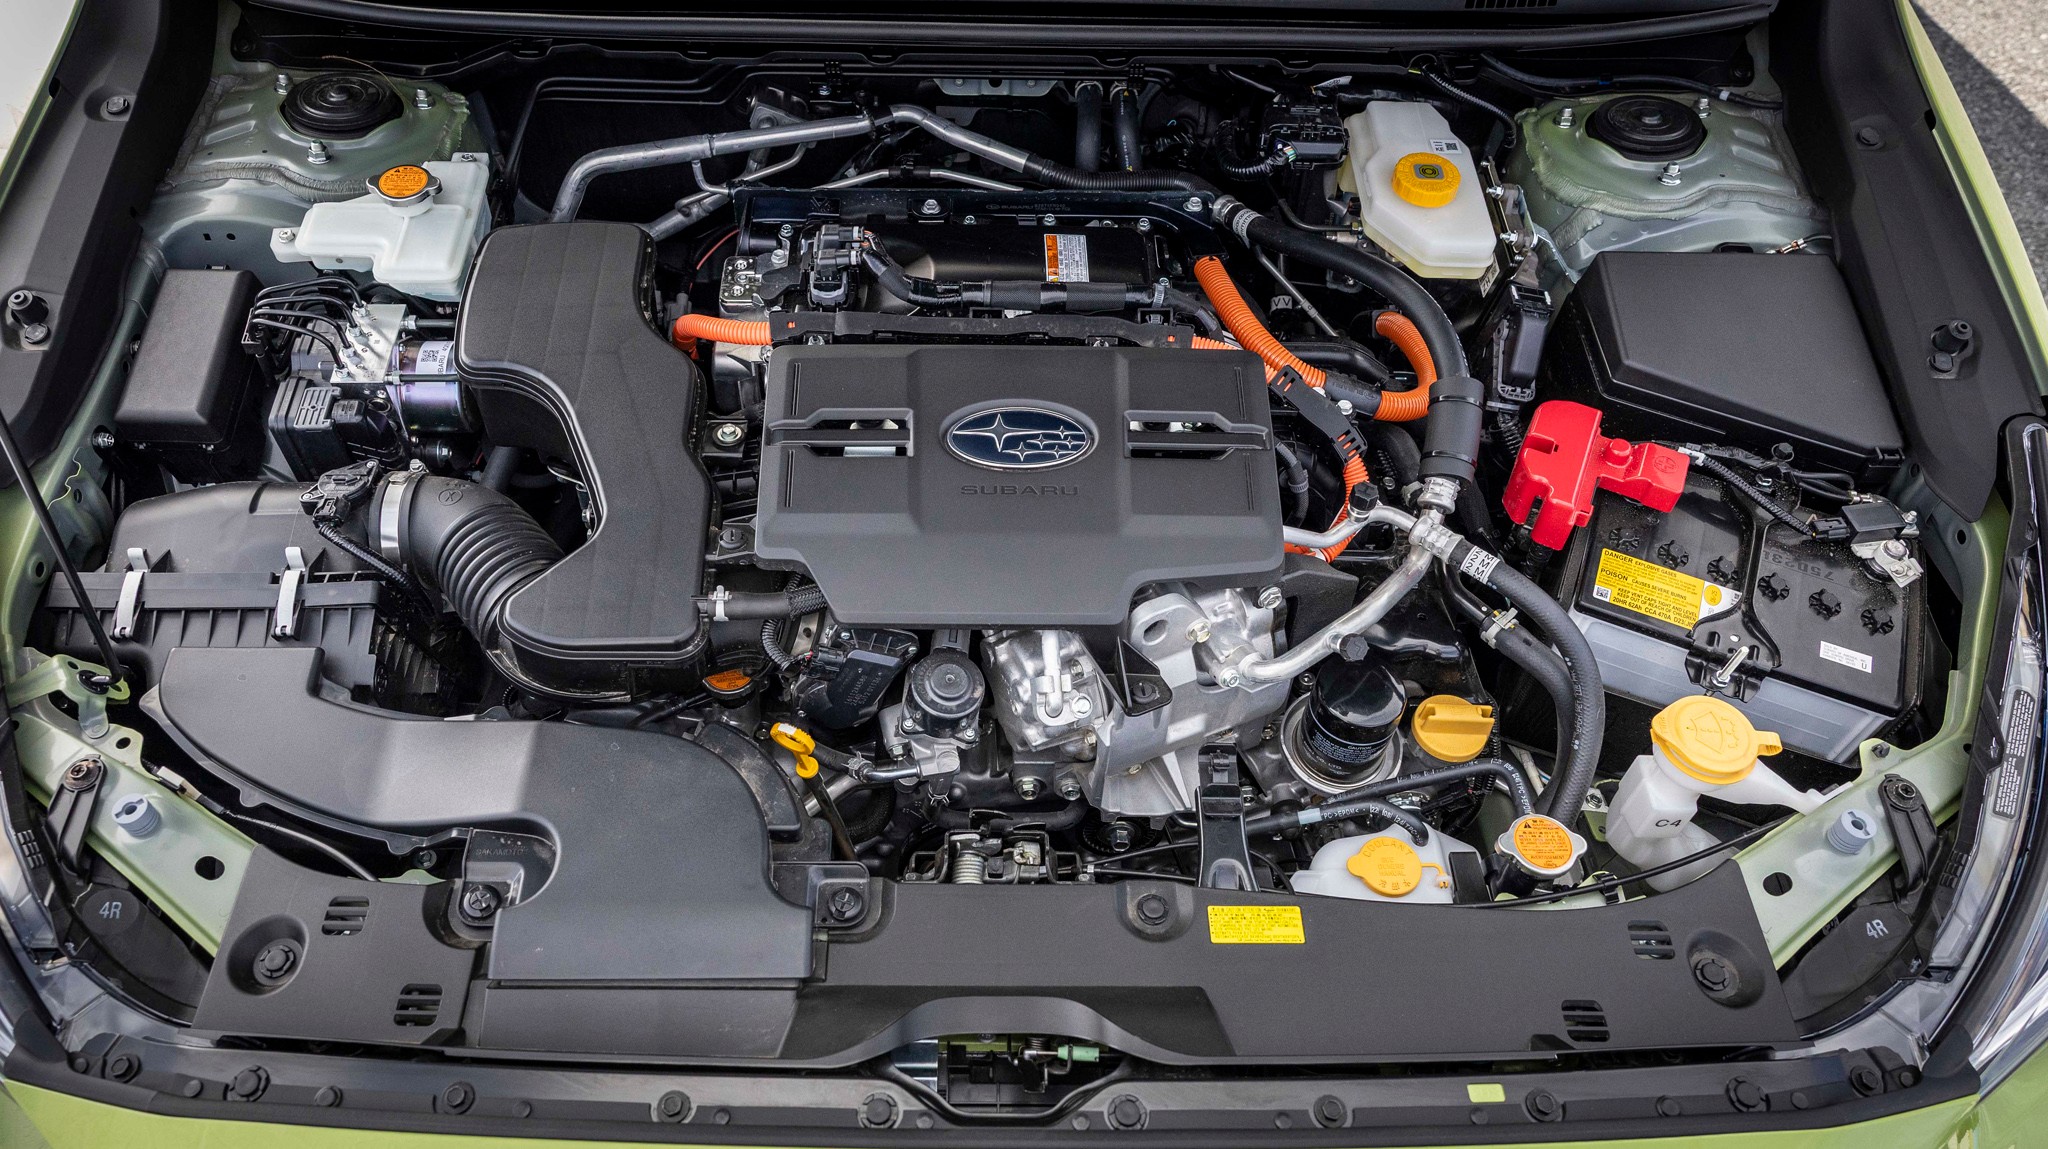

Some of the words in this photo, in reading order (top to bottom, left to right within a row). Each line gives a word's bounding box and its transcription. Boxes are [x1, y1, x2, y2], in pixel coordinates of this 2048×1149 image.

[960, 485, 1078, 496] SUBARU
[1604, 550, 1633, 564] DANGER
[1635, 560, 1660, 573] EXPLOSIVE
[1661, 568, 1677, 578] GASES
[1600, 568, 1628, 581] POISON
[1632, 578, 1650, 589] CAUSES
[1651, 584, 1670, 595] SEVERE
[1671, 590, 1687, 600] BURNS
[1613, 596, 1628, 606] 20HR
[1644, 607, 1657, 616] CCA
[1658, 611, 1672, 620] 470A
[1683, 609, 1698, 618] LEVEL
[1861, 662, 1868, 670] U
[1363, 840, 1413, 857] COOLANT
[99, 901, 122, 919] 4R
[1866, 919, 1888, 939] 4R
